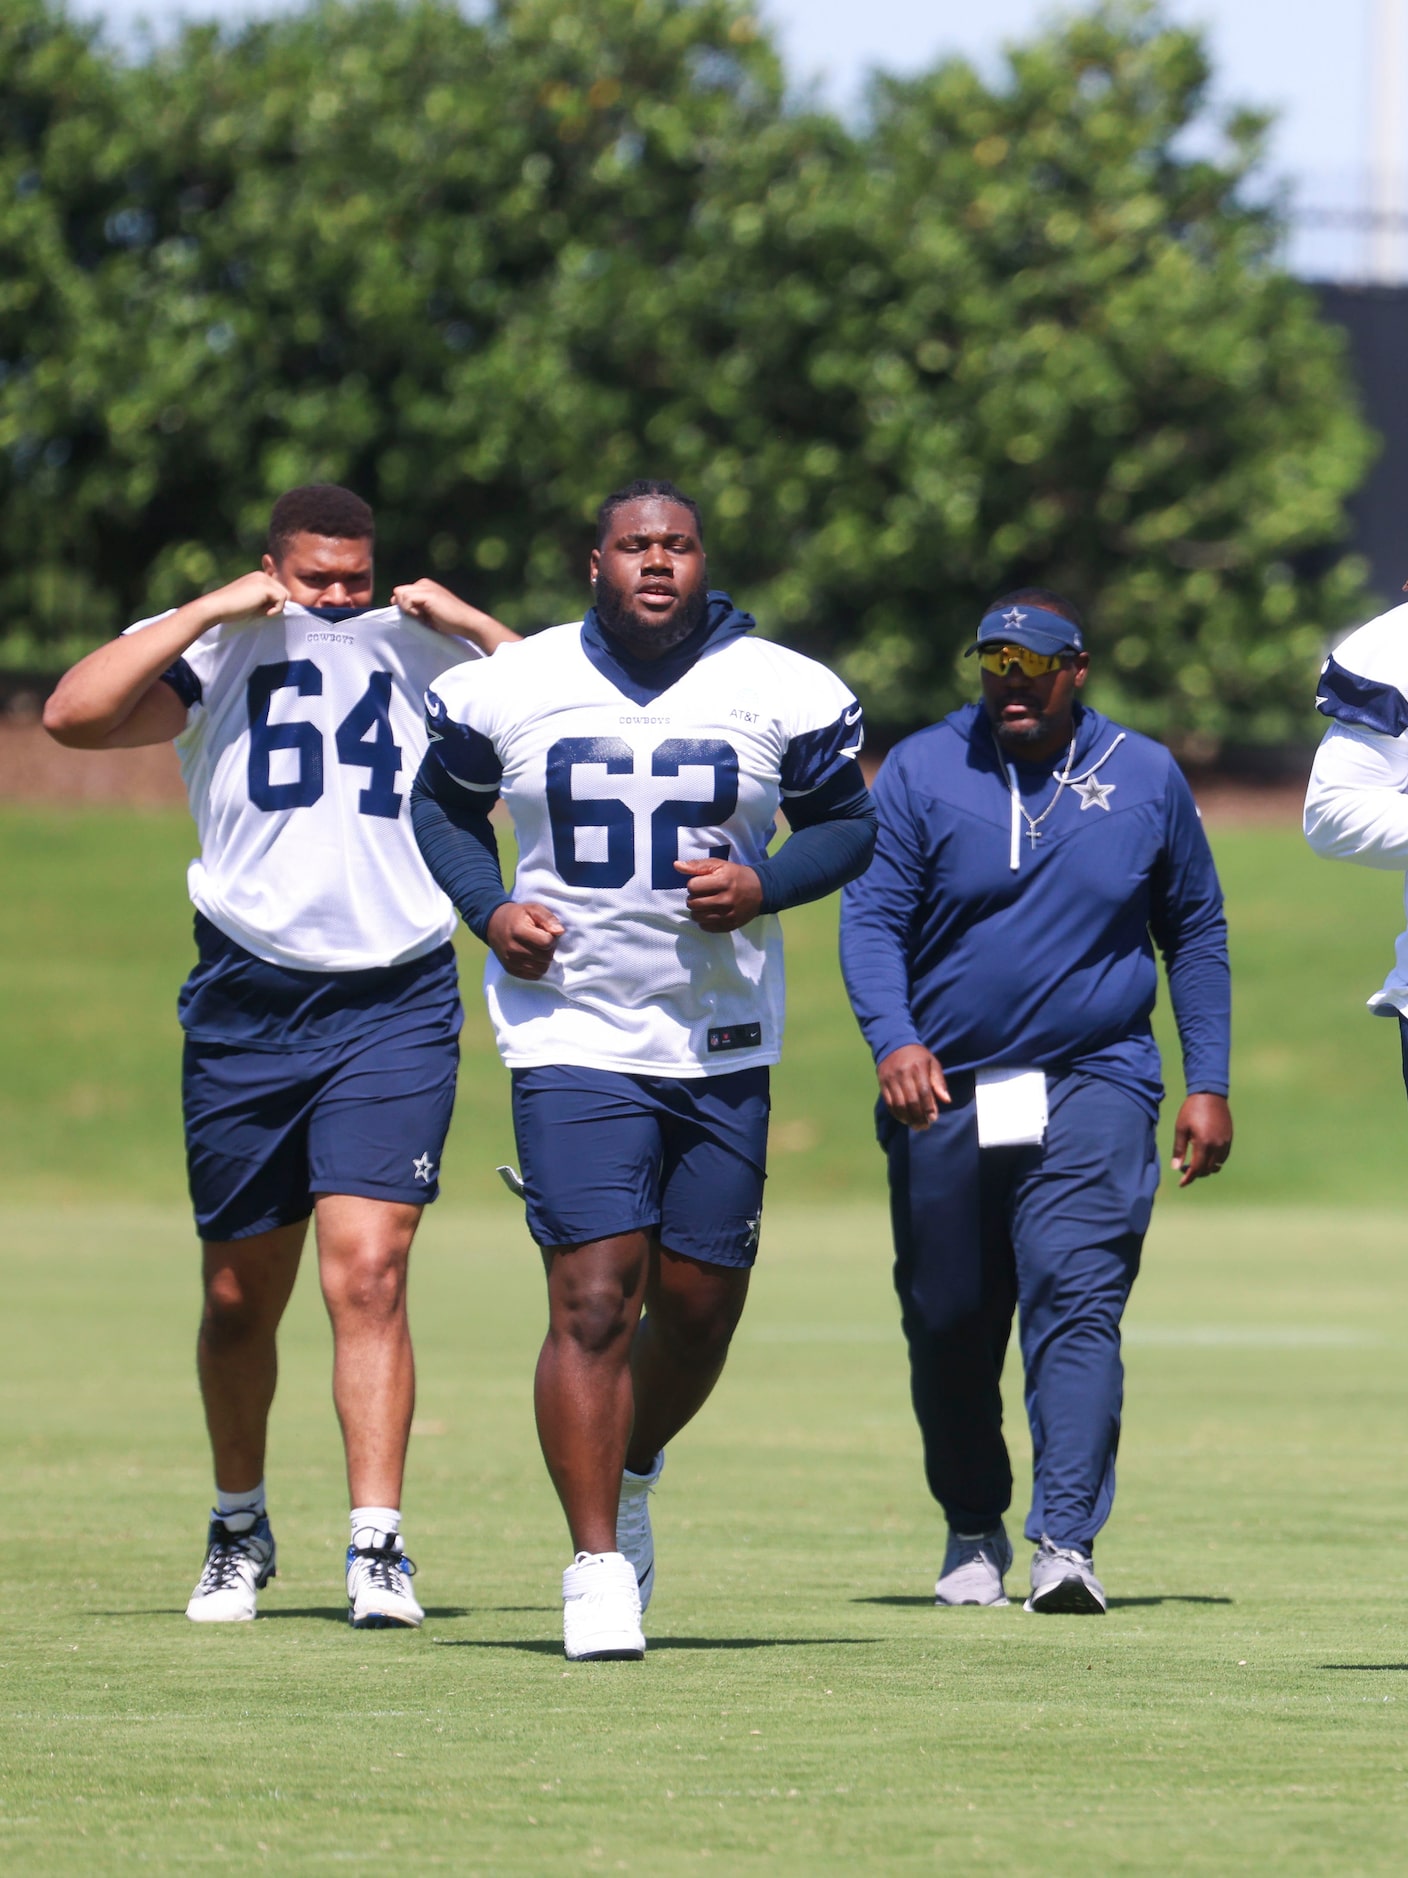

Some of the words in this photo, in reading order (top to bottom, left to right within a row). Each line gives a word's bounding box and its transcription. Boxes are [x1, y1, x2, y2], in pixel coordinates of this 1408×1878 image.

[307, 633, 354, 645] COWBOYS
[619, 716, 671, 725] COWBOYS
[730, 708, 760, 724] AT&T
[247, 659, 403, 820] 64
[546, 736, 739, 890] 62
